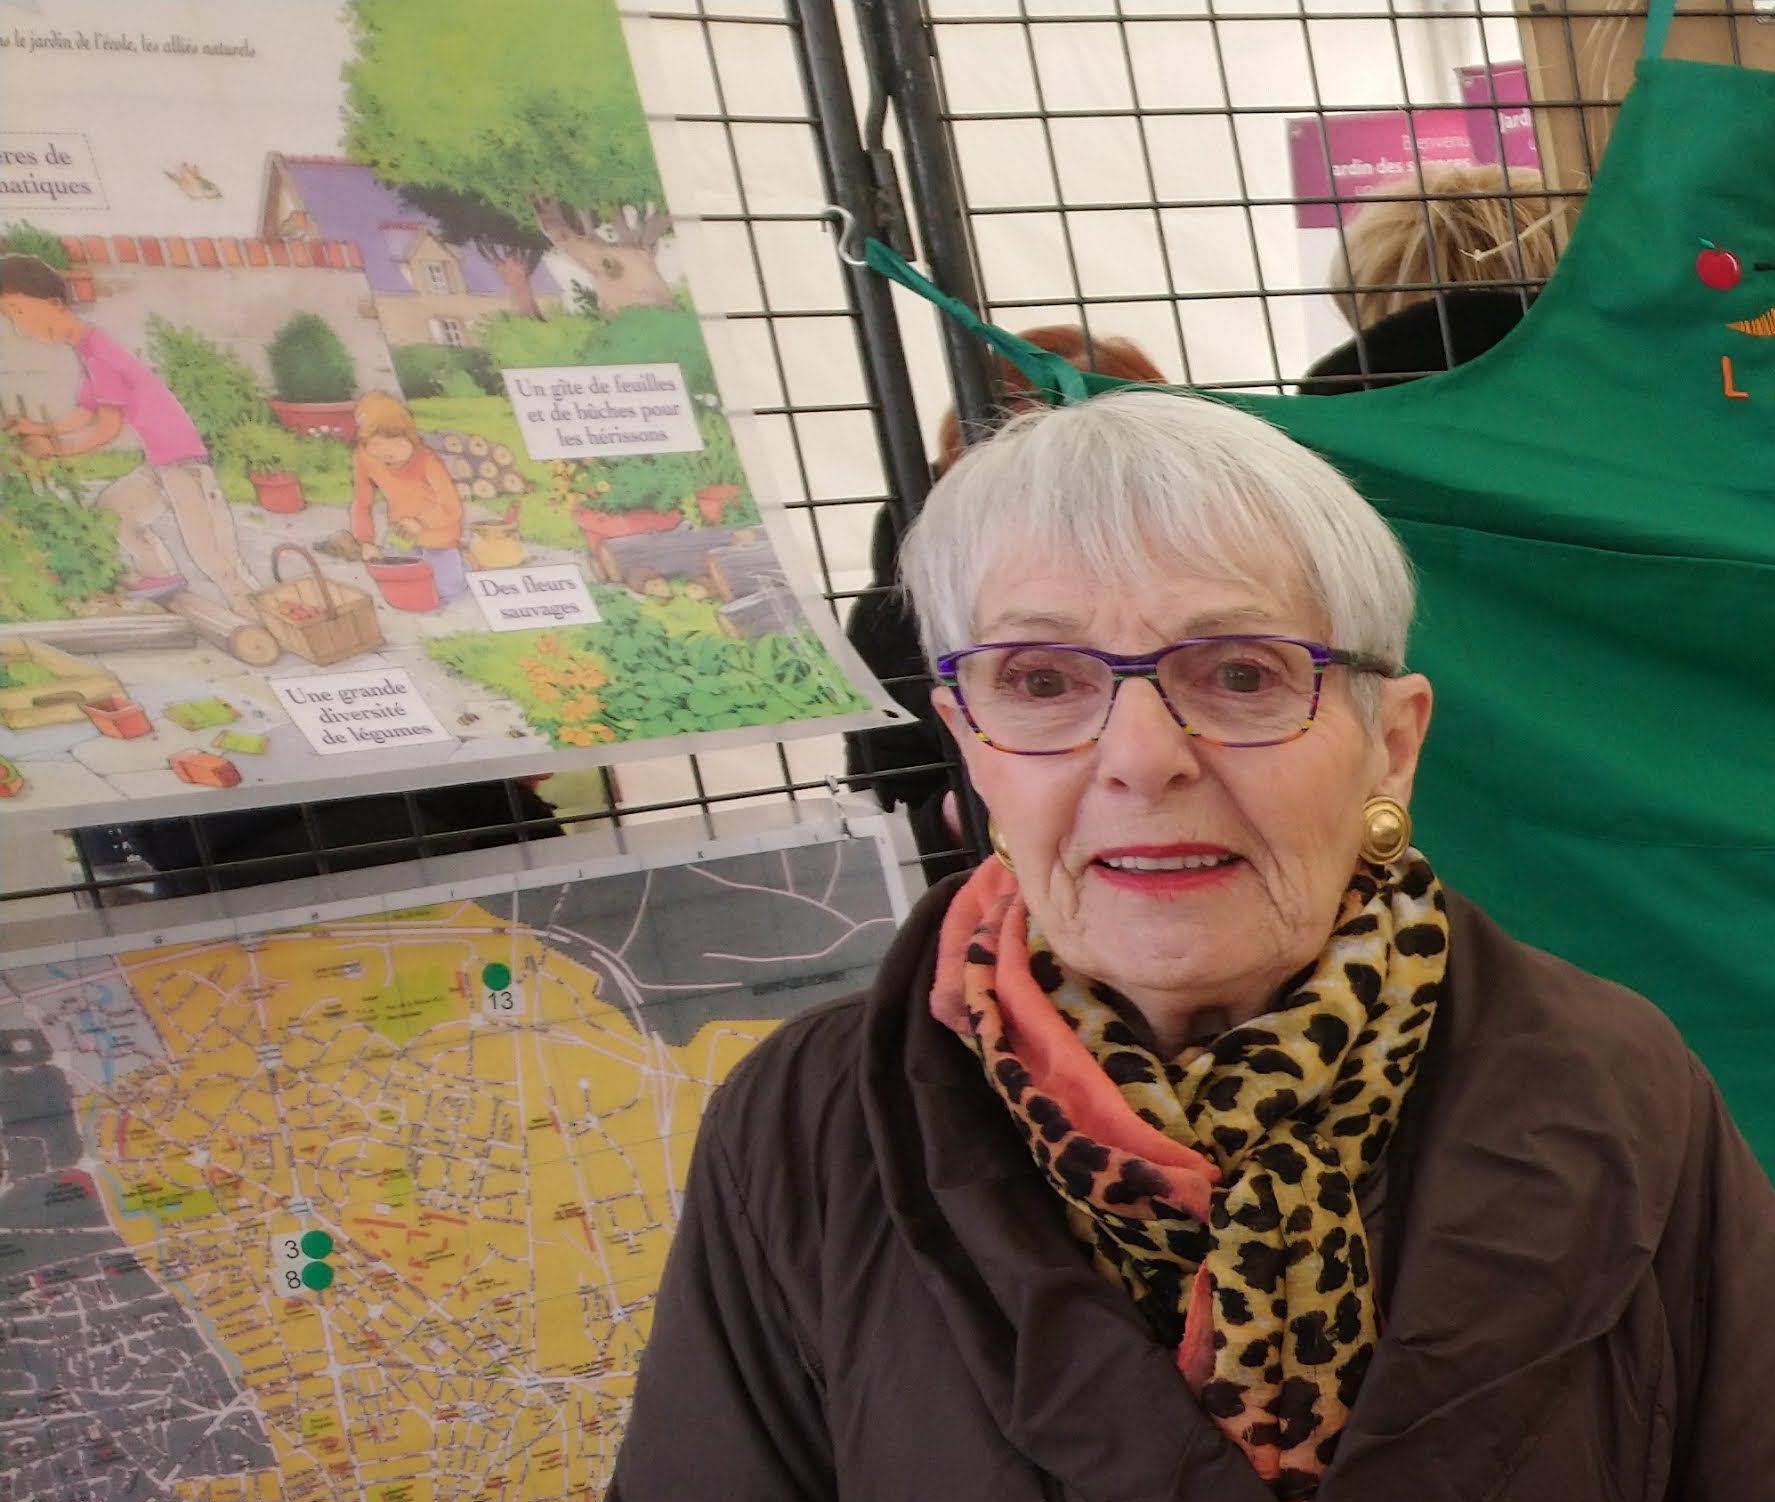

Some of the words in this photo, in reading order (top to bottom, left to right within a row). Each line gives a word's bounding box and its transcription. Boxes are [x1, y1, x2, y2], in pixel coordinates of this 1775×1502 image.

[30, 30, 72, 52] jardin
[202, 37, 256, 58] naturels
[46, 142, 71, 165] de
[515, 379, 546, 397] Un
[551, 378, 583, 400] gîte
[589, 376, 609, 394] de
[614, 373, 676, 393] feuilles
[527, 411, 545, 422] et
[551, 403, 570, 421] de
[573, 401, 636, 421] bûches
[641, 404, 680, 422] pour
[557, 427, 583, 446] les
[584, 426, 668, 445] hérissons
[480, 579, 519, 597] Des
[521, 575, 577, 594] fleurs
[501, 602, 581, 620] sauvages
[285, 688, 333, 704] Une
[339, 678, 406, 707] grande
[318, 705, 406, 724] diversité
[322, 729, 345, 746] de
[353, 723, 432, 744] légumes
[488, 991, 514, 1010] 13
[284, 1239, 300, 1260] 3
[285, 1270, 301, 1289] 8
